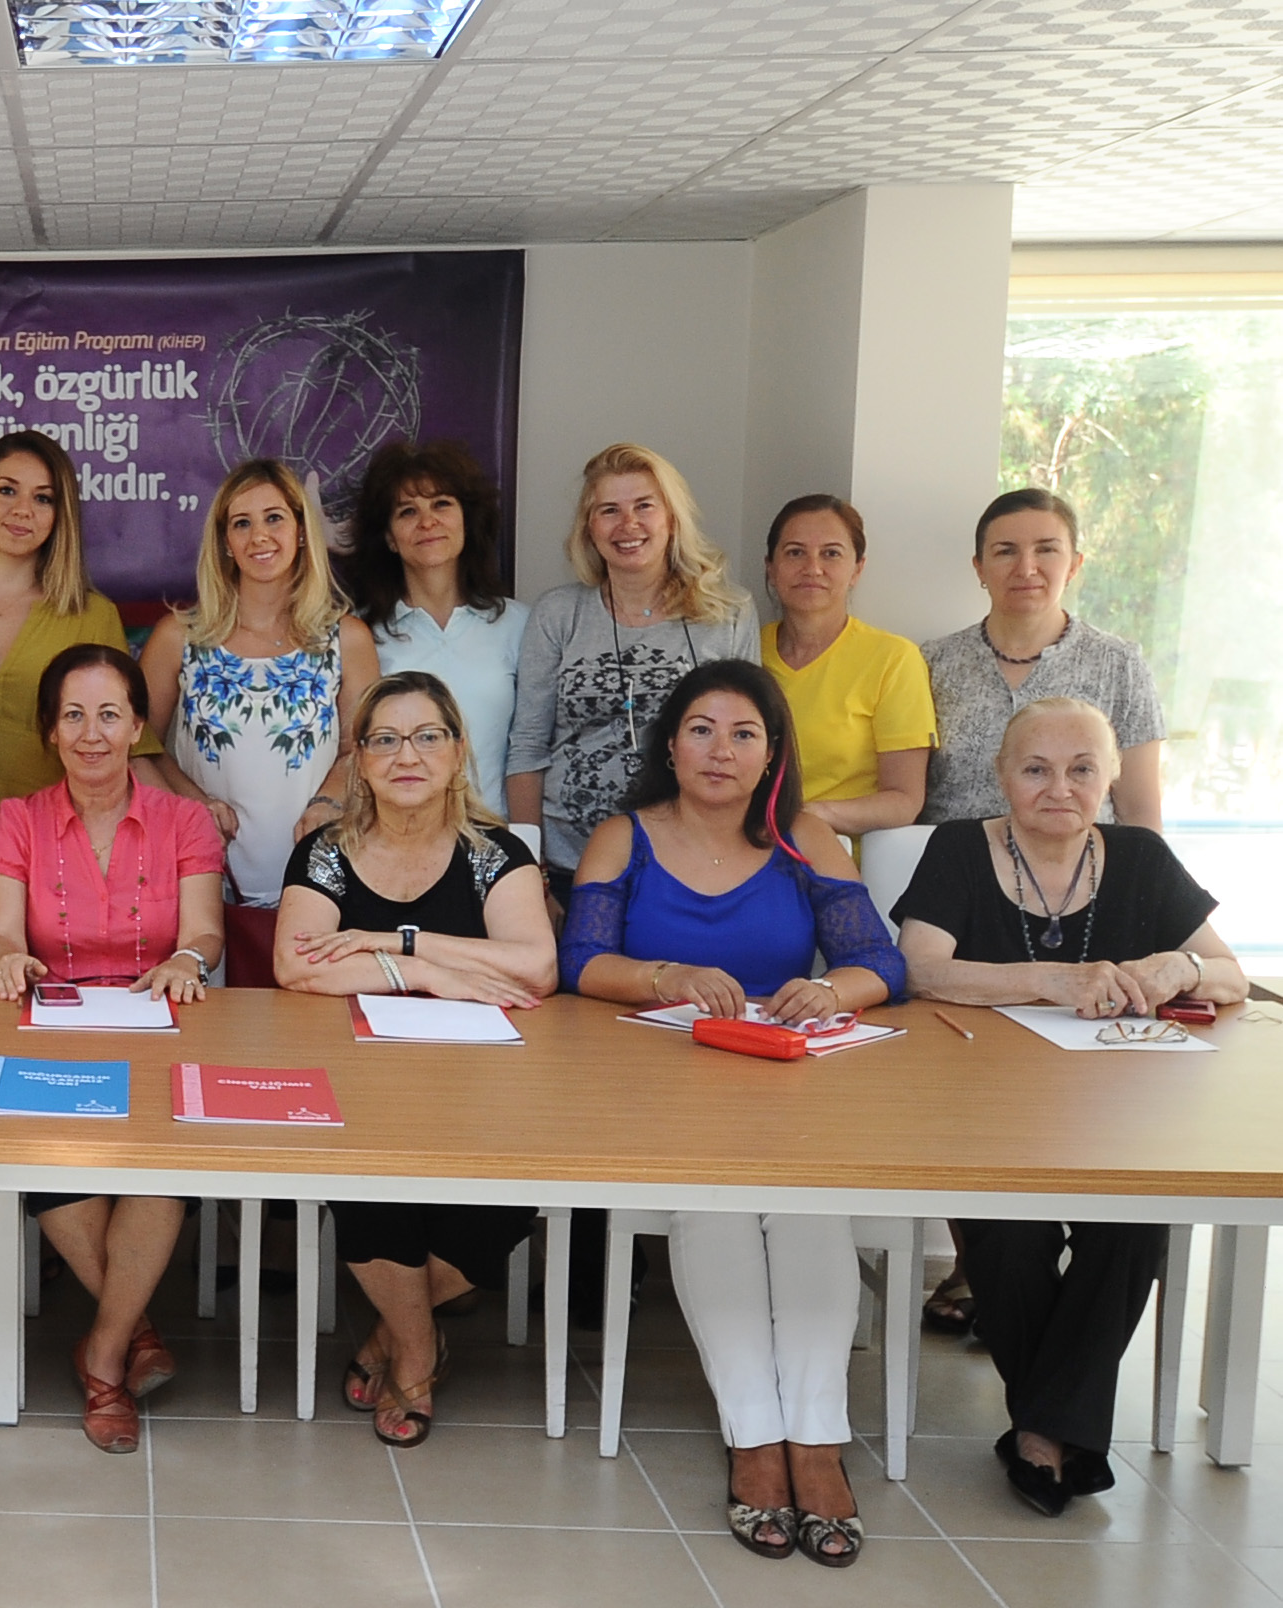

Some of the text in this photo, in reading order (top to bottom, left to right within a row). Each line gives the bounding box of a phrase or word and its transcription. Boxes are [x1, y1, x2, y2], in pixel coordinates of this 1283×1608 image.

[15, 330, 69, 356] Eğitim
[74, 330, 154, 355] Programı
[157, 332, 207, 353] (KİHEP)
[34, 359, 200, 412] özgürlük
